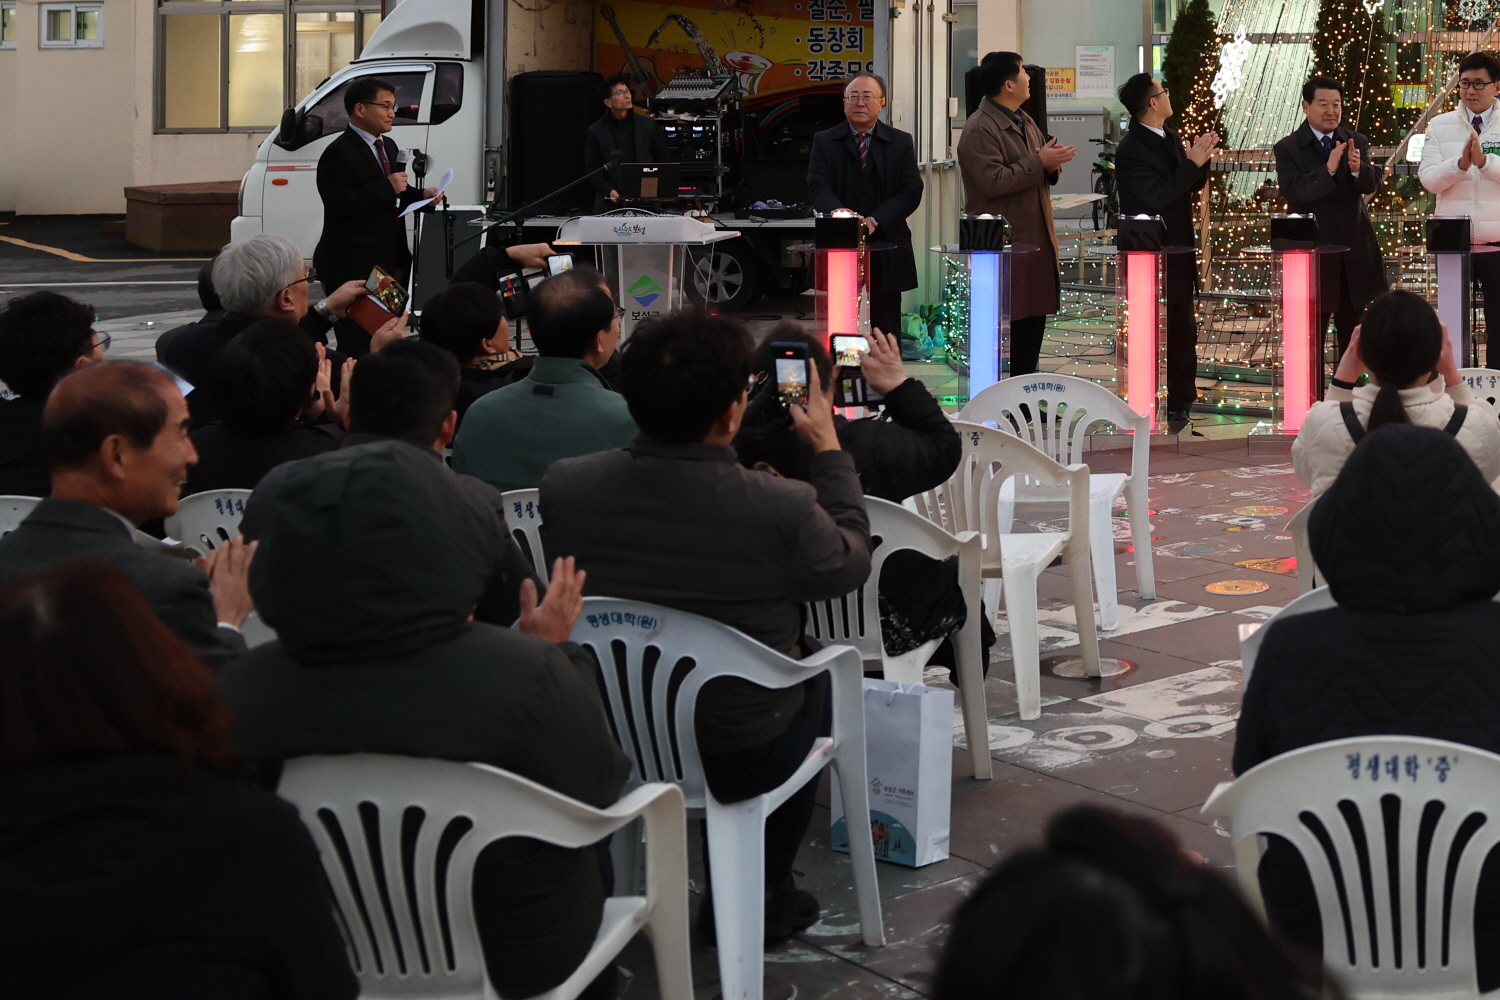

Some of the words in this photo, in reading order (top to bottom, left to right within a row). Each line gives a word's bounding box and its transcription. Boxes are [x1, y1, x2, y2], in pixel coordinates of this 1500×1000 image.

[807, 26, 864, 53] 동창회
[586, 612, 657, 630] 평생대학(원)
[1346, 751, 1420, 783] 평생대학
